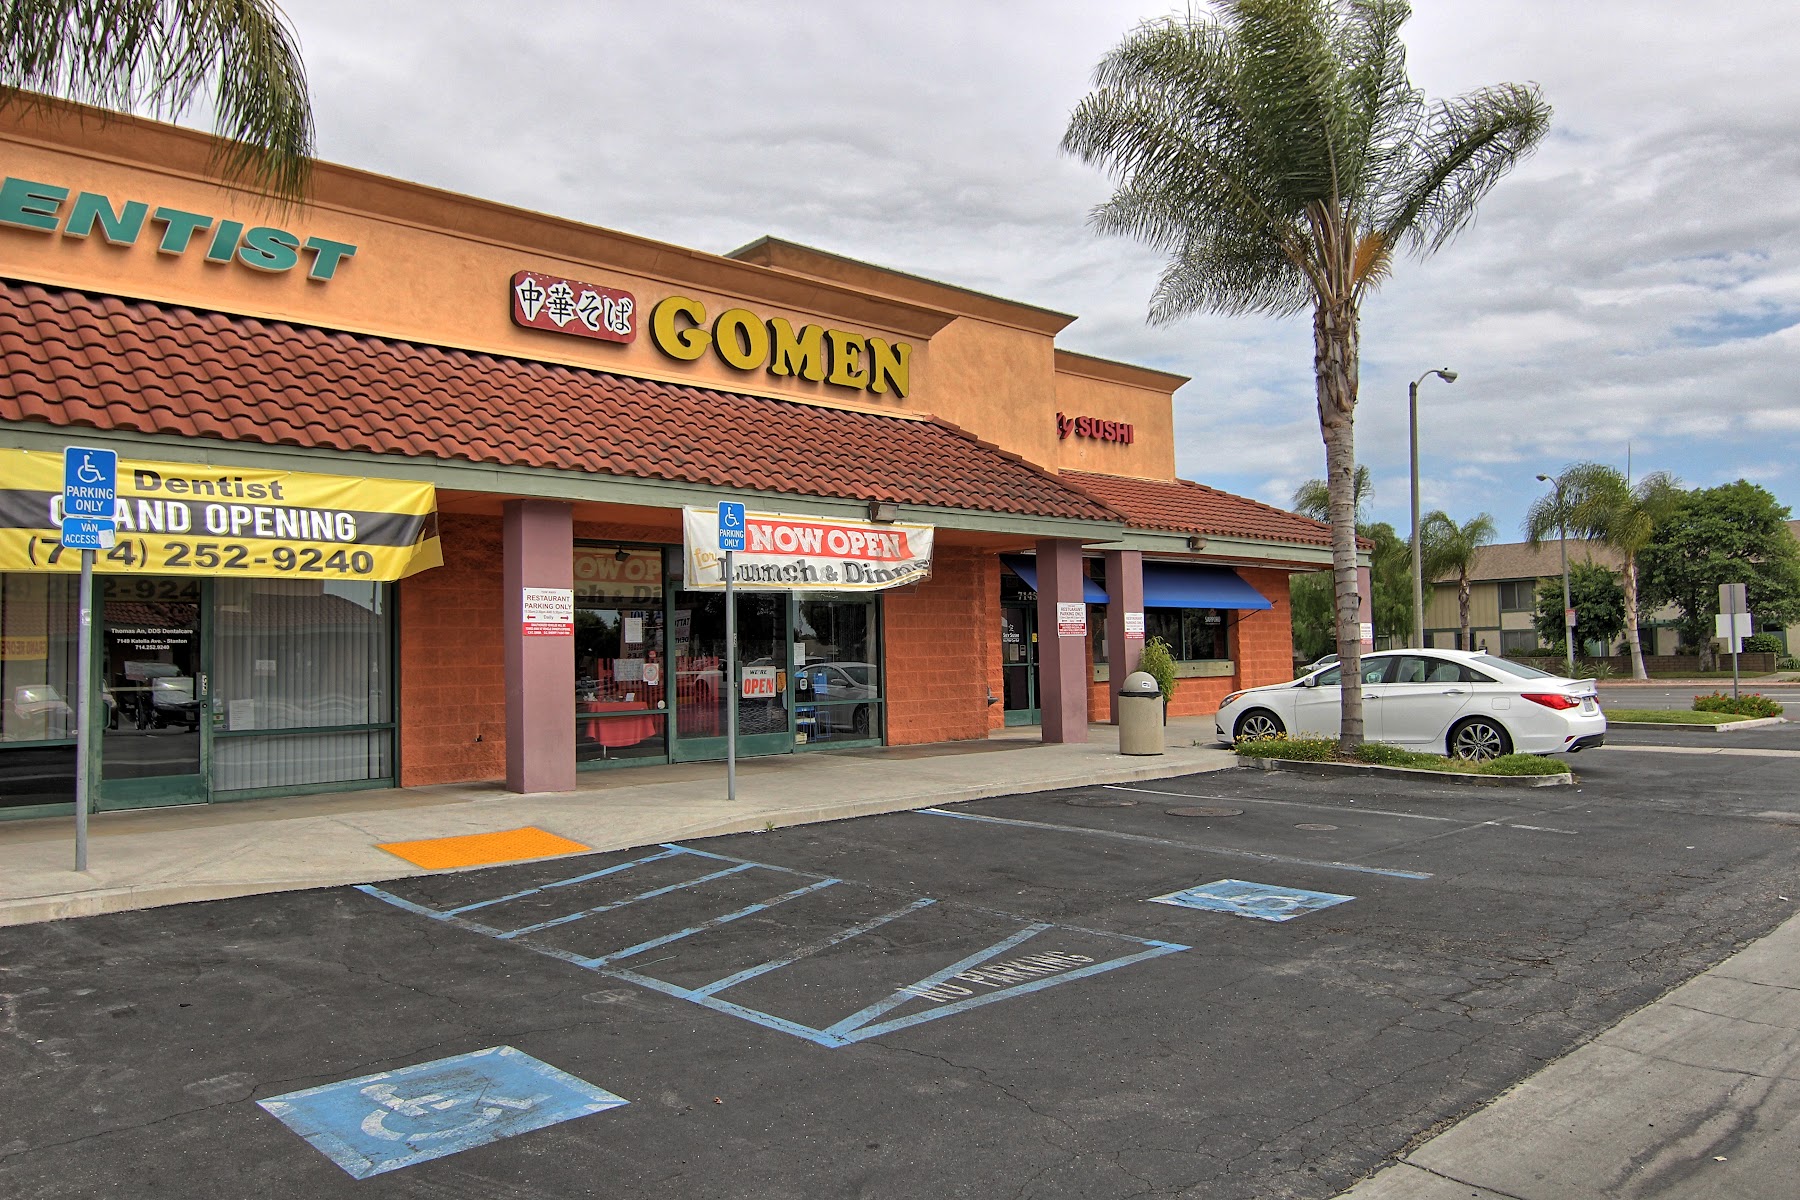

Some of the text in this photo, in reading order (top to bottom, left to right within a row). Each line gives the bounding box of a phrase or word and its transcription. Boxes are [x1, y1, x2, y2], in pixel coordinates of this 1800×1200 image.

[0, 176, 358, 282] ENTIST
[518, 279, 634, 333] 中華そば
[648, 296, 912, 398] GOMEN
[1075, 416, 1134, 444] SUSHI
[66, 485, 114, 500] PARKING
[134, 469, 284, 501] Dentist
[75, 499, 104, 512] ONLY
[51, 494, 357, 543] AND OPENING
[81, 522, 99, 532] VAN
[65, 533, 99, 545] ACCESSI
[719, 529, 744, 539] PARKING
[724, 538, 740, 549] ONLY
[747, 524, 902, 558] NOW OPEN
[163, 541, 375, 575] 252-9240
[716, 558, 819, 583] Lunch
[820, 564, 838, 582] &
[524, 602, 554, 610] PARKING
[526, 594, 570, 602] RESTAURANT
[743, 677, 774, 695] OPEN
[953, 950, 1095, 987] PARKING
